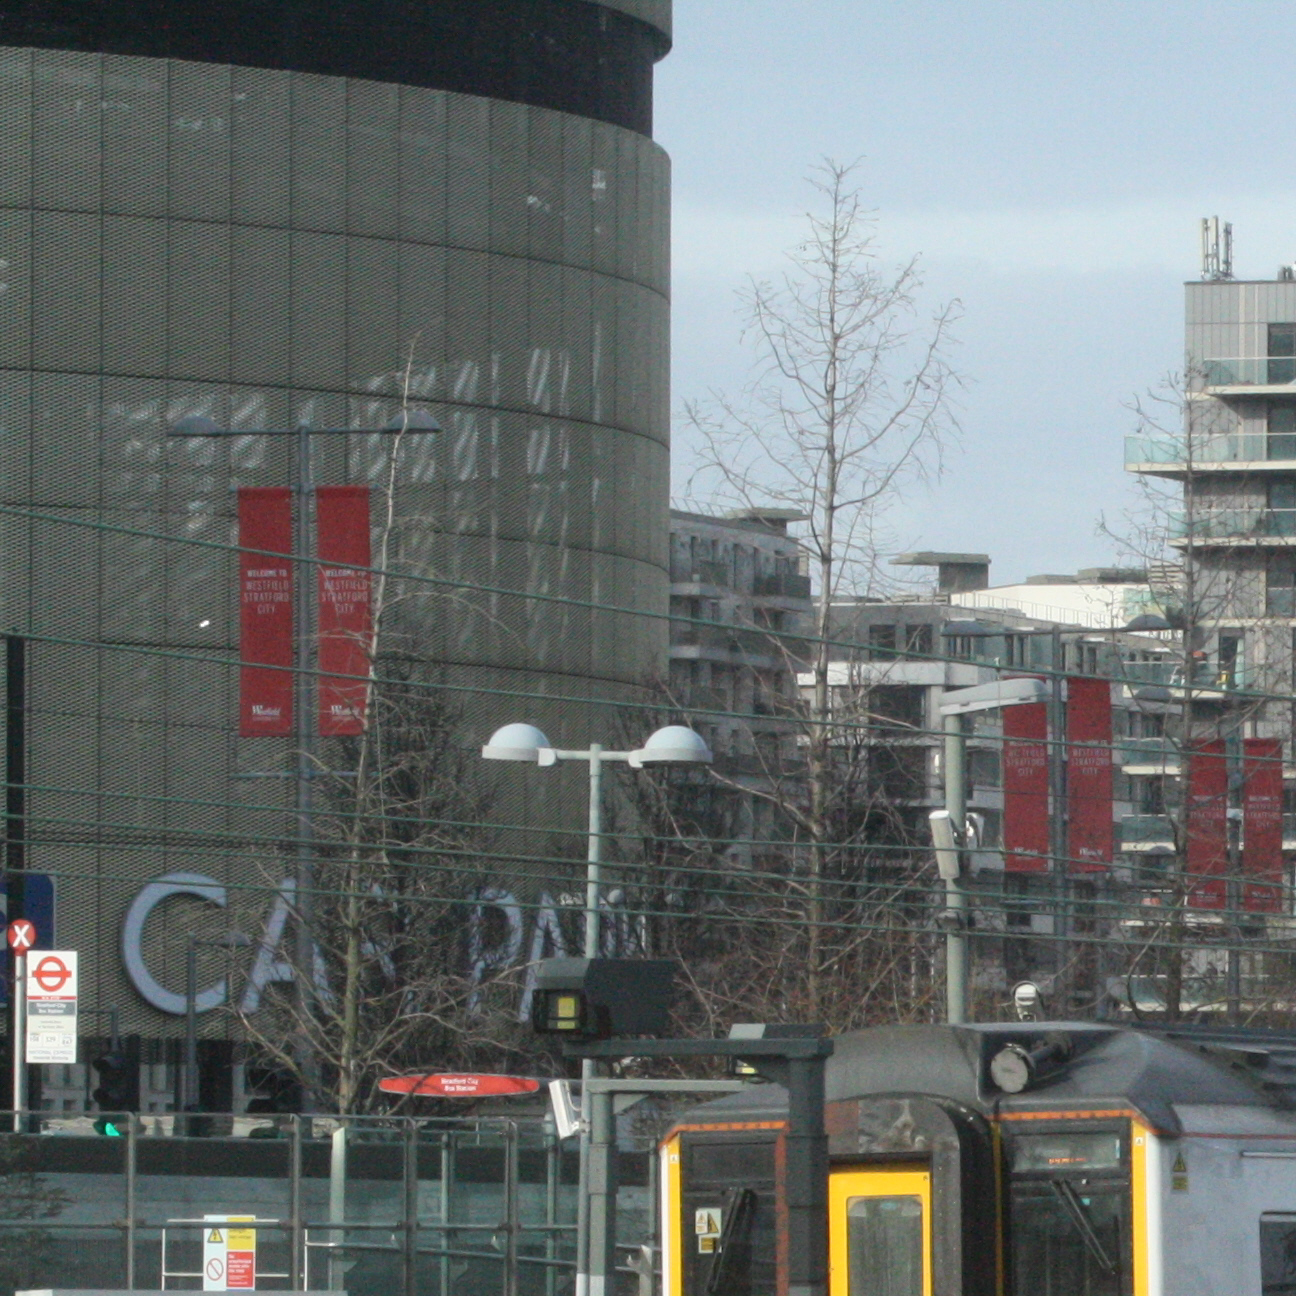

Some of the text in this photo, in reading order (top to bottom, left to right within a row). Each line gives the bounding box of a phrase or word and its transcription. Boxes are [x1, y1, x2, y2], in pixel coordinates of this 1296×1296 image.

[244, 592, 289, 602] STRATFORD
[257, 604, 275, 614] CITY
[12, 924, 31, 948] X
